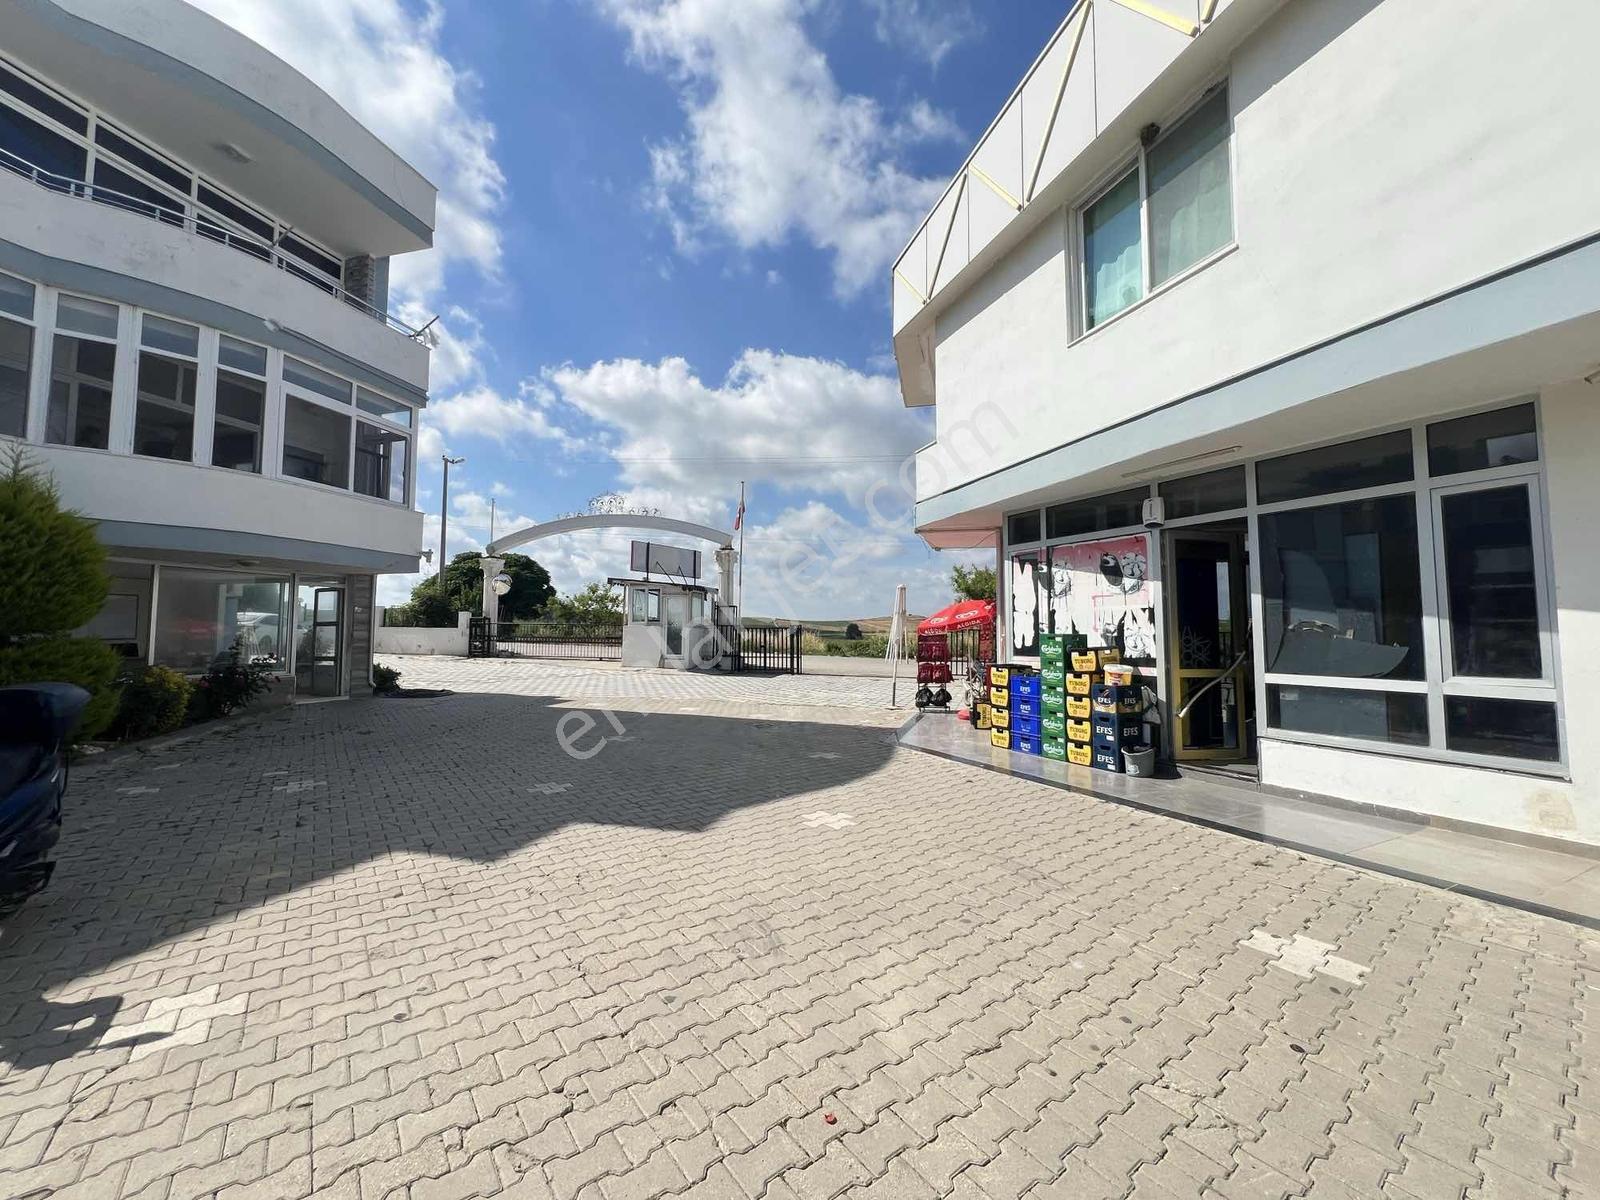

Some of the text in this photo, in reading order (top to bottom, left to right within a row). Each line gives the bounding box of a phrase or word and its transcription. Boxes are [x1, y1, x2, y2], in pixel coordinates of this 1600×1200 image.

[1096, 725, 1113, 735] EFES
[1123, 727, 1138, 736] EFES
[1097, 754, 1113, 764] EFES
